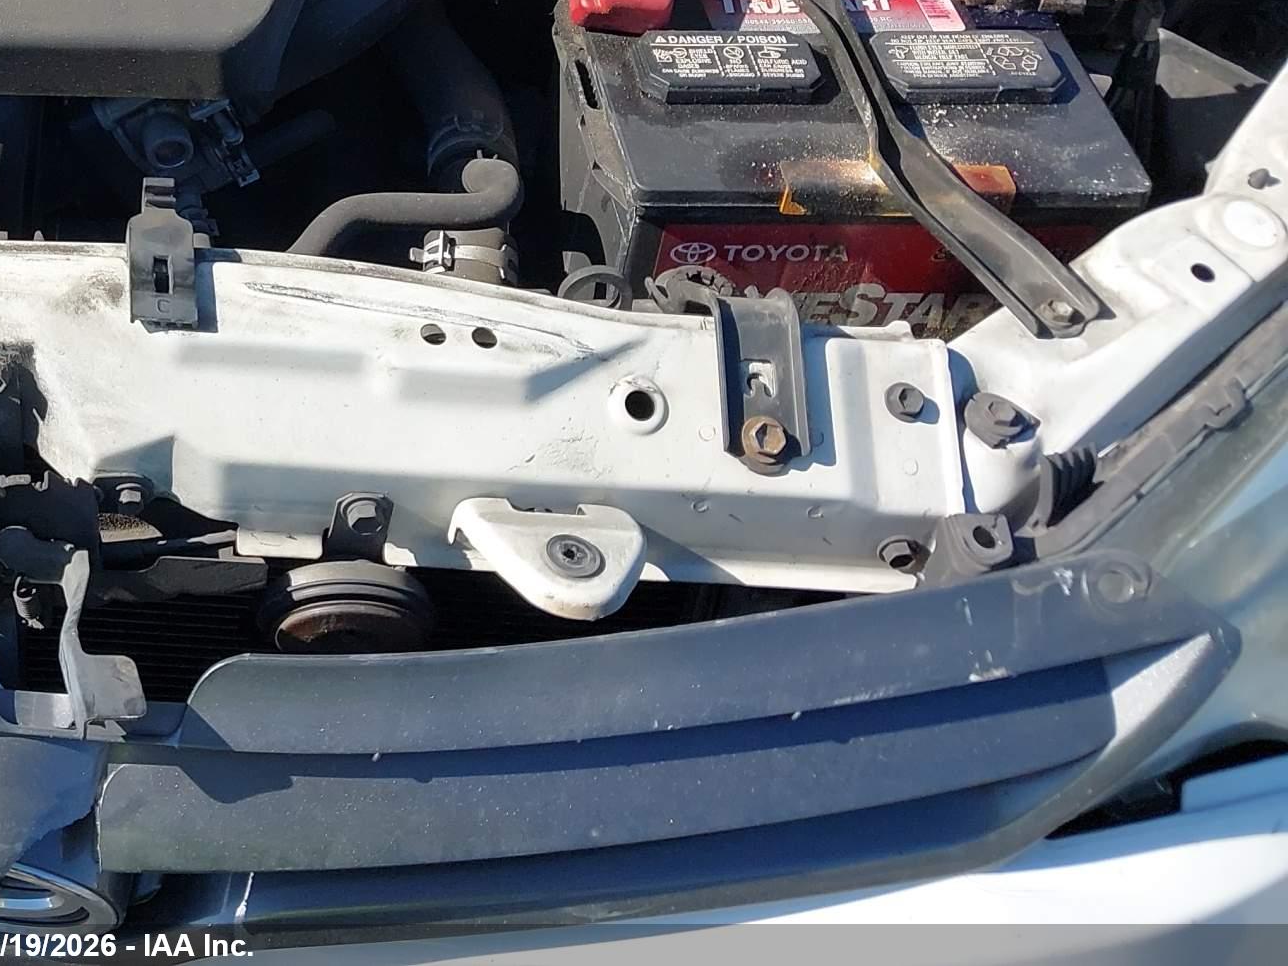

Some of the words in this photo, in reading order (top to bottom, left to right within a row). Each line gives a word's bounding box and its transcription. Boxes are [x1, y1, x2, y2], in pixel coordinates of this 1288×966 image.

[668, 35, 723, 44] DANGER
[737, 35, 787, 44] POISON
[723, 243, 850, 263] TOYOTA
